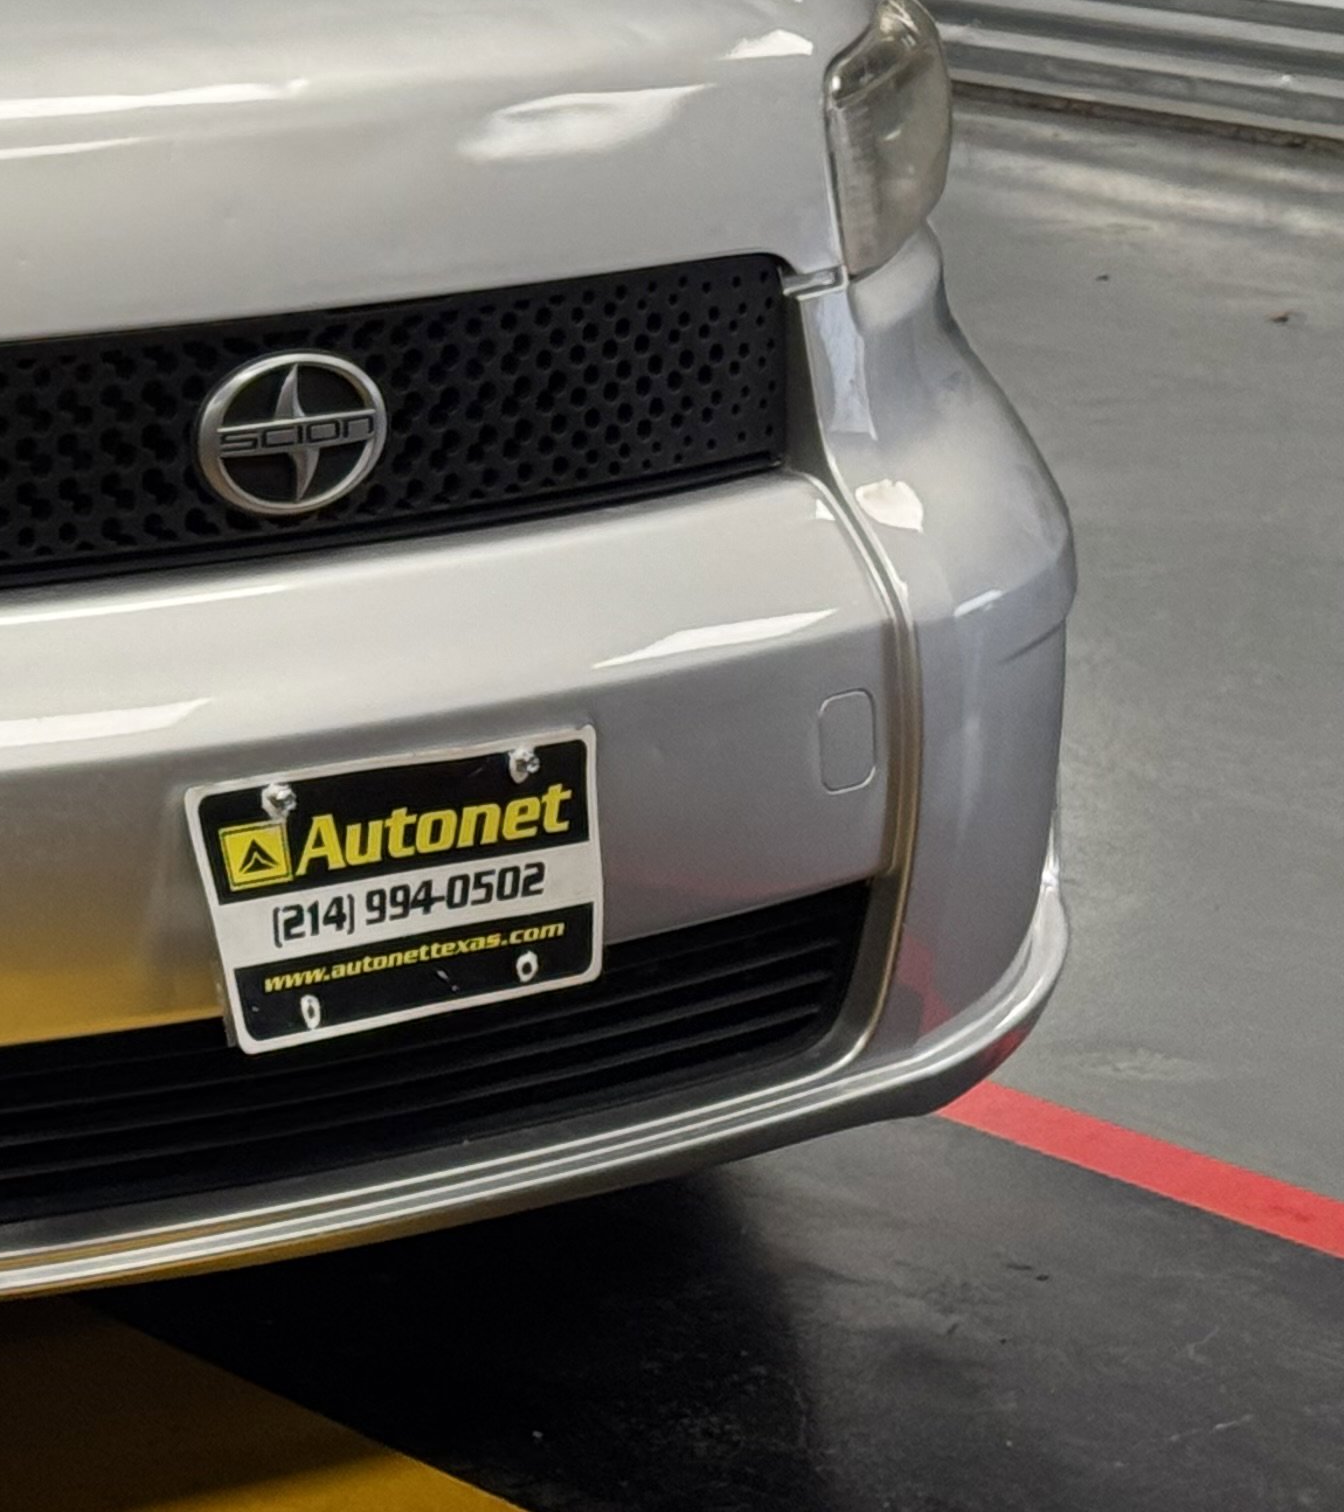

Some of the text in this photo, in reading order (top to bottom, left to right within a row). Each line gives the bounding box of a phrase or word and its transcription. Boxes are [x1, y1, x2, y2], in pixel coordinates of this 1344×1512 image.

[296, 784, 572, 876] Autonet
[272, 861, 546, 948] (214) 994-0502
[264, 921, 566, 993] www.autonettexas.com
